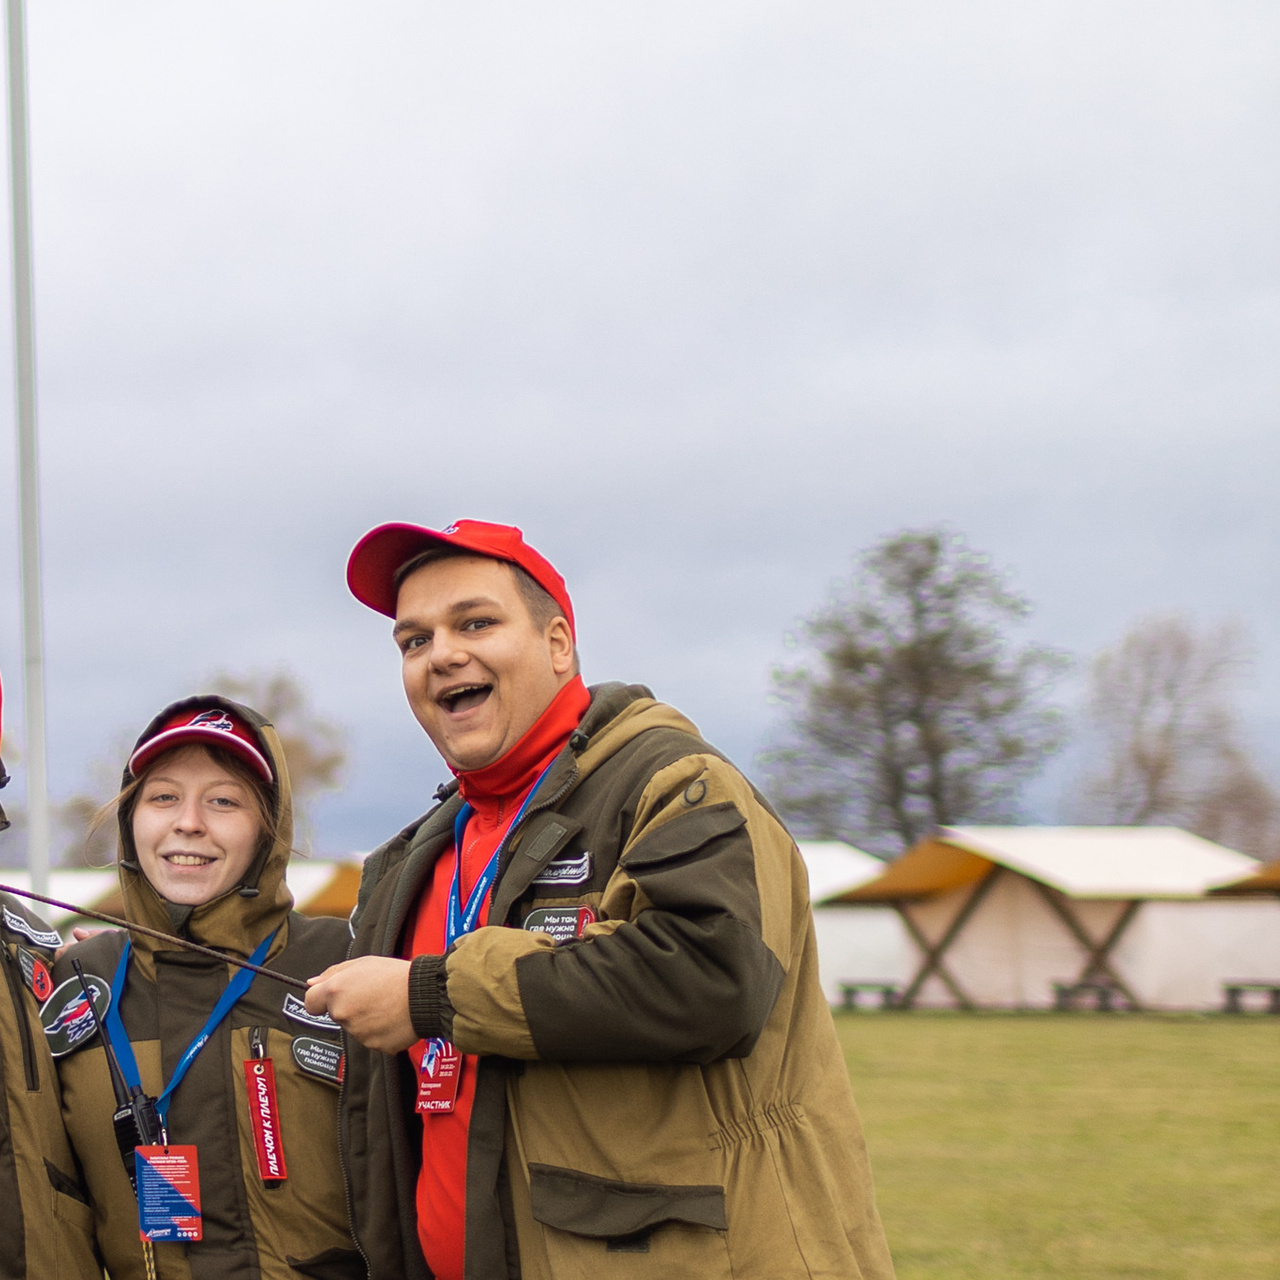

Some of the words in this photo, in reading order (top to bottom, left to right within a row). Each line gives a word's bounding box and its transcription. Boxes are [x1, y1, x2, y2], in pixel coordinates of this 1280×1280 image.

[544, 915, 560, 923] Мы
[561, 915, 578, 924] там,
[545, 924, 575, 933] нужна
[310, 1044, 323, 1054] Мы
[297, 1047, 311, 1056] где
[311, 1051, 337, 1064] нужна
[304, 1056, 336, 1071] помощь
[417, 1100, 451, 1110] УЧАСТНИК
[262, 1120, 273, 1129] К
[263, 1129, 280, 1176] ПЛЕЧОМ
